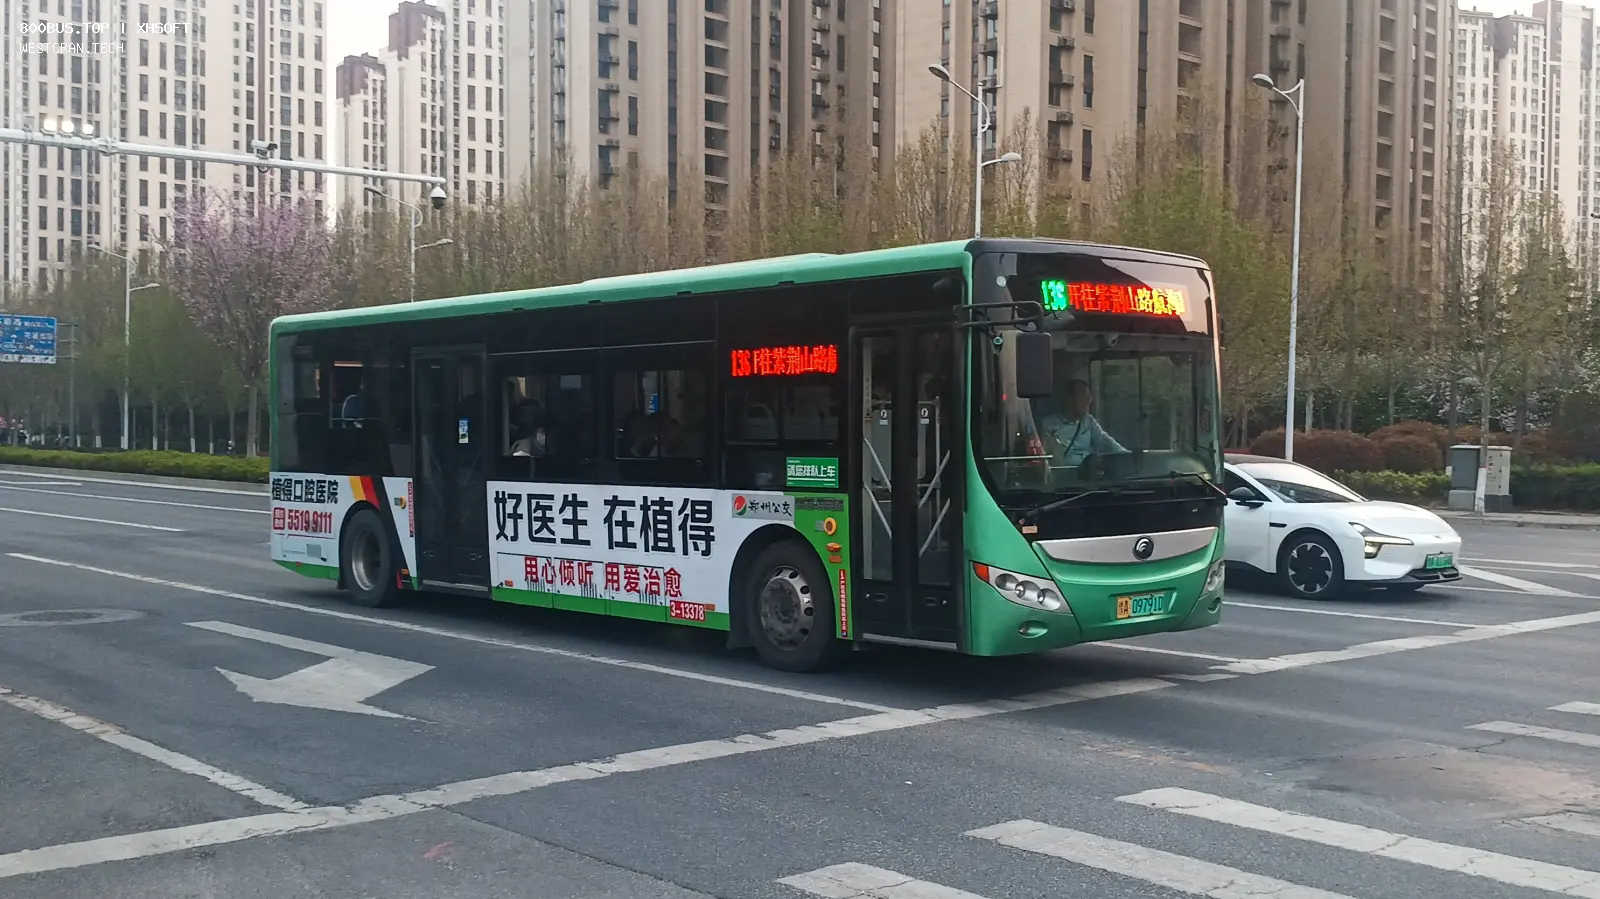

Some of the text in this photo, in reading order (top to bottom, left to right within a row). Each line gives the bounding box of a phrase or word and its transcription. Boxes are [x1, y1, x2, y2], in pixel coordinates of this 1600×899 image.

[271, 478, 339, 504] 植得口腔医院
[748, 500, 792, 517] 郑州公交
[287, 509, 310, 532] 5519
[312, 511, 333, 534] 9111
[494, 490, 716, 557] 好医生 在植得
[524, 556, 683, 598] 用心倾听 用爱治愈
[669, 602, 705, 621] 3-13378
